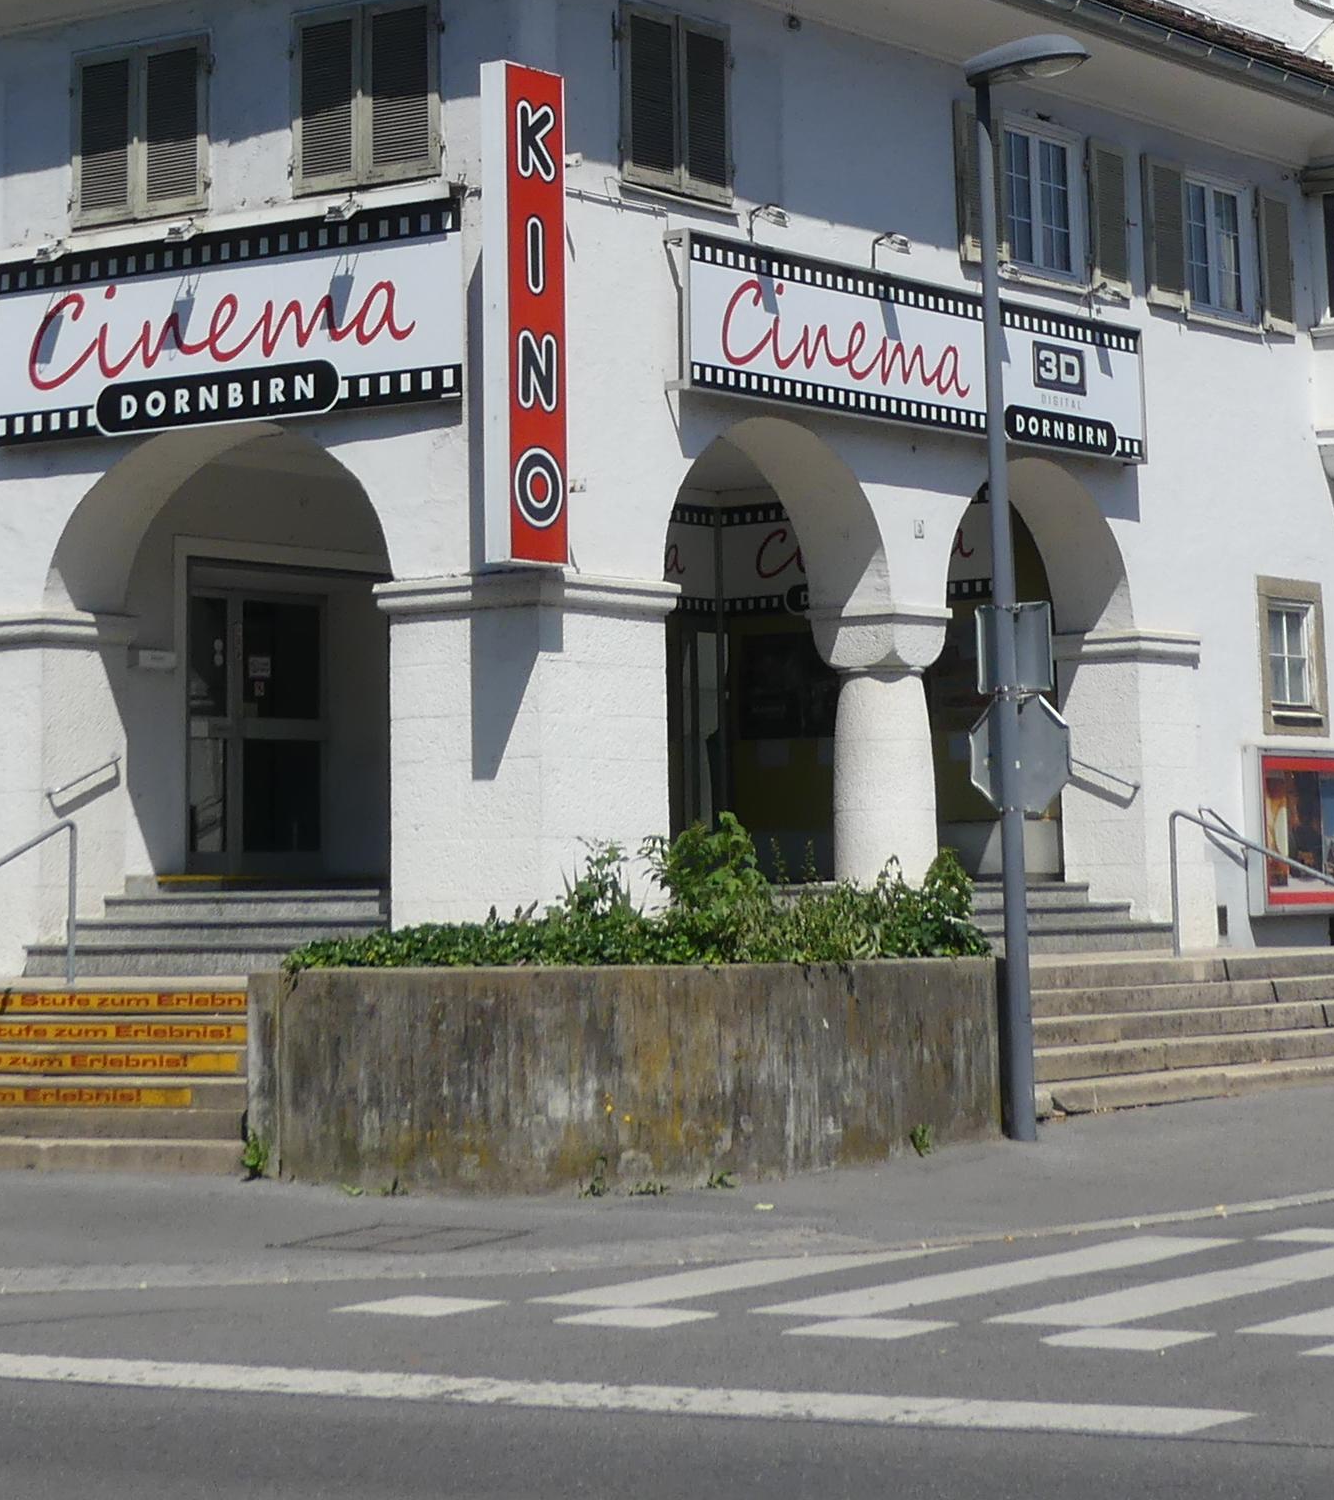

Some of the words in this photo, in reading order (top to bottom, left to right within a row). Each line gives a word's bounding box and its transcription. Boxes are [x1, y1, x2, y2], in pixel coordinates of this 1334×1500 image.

[514, 100, 563, 529] KINO
[28, 280, 416, 391] Cinema
[721, 279, 971, 398] Cinema
[1039, 349, 1080, 385] 3D
[120, 373, 316, 422] DORNBIRN
[1041, 394, 1082, 411] DIGITAL
[1015, 414, 1108, 447] DORNBIRN
[21, 992, 90, 1007] Stufe
[97, 996, 150, 1007] zum
[157, 992, 247, 1007] Erlebni
[54, 1027, 107, 1038] zum
[115, 1024, 232, 1039] Erlebnis!
[71, 1053, 188, 1068] Erlebnis!
